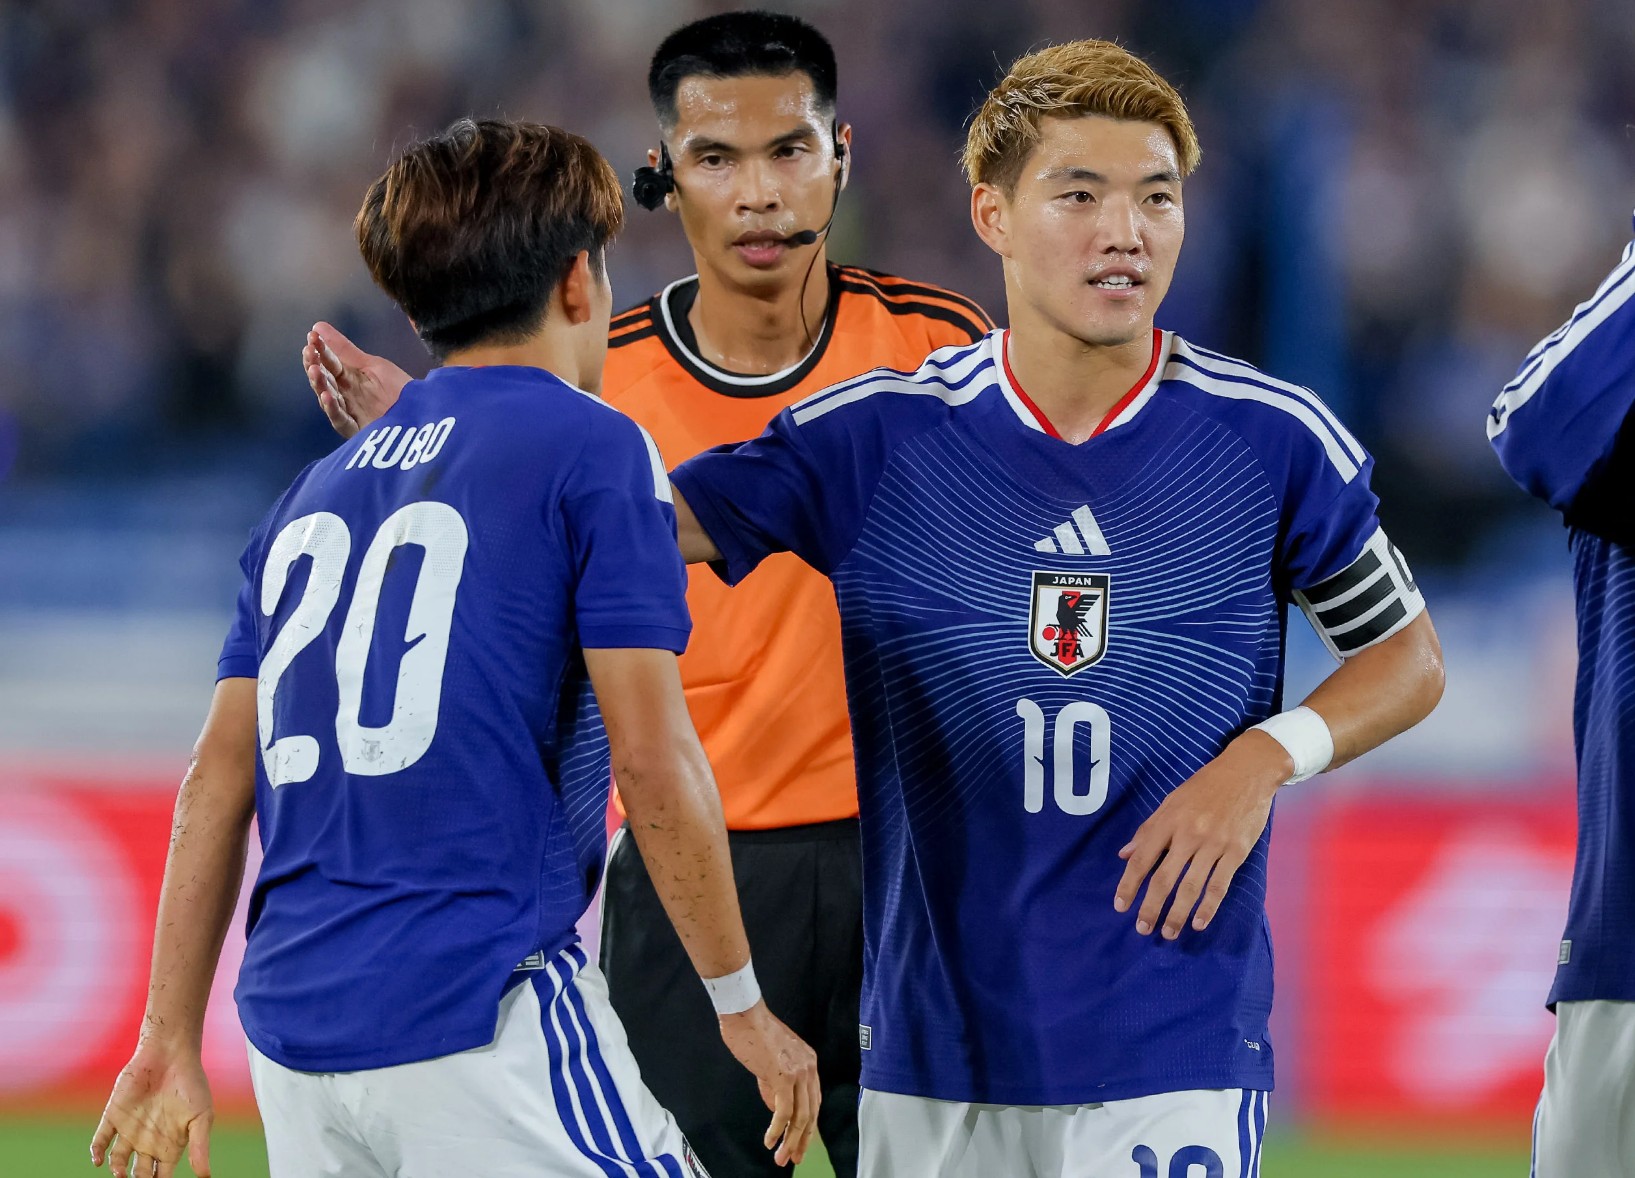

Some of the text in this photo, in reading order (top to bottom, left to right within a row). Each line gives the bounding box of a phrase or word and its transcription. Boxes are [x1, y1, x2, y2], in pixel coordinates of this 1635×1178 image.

[345, 416, 456, 471] KUBO
[1052, 576, 1092, 586] JAPAN
[256, 501, 469, 790] 20
[1050, 642, 1085, 658] JFA
[1016, 698, 1111, 815] 10
